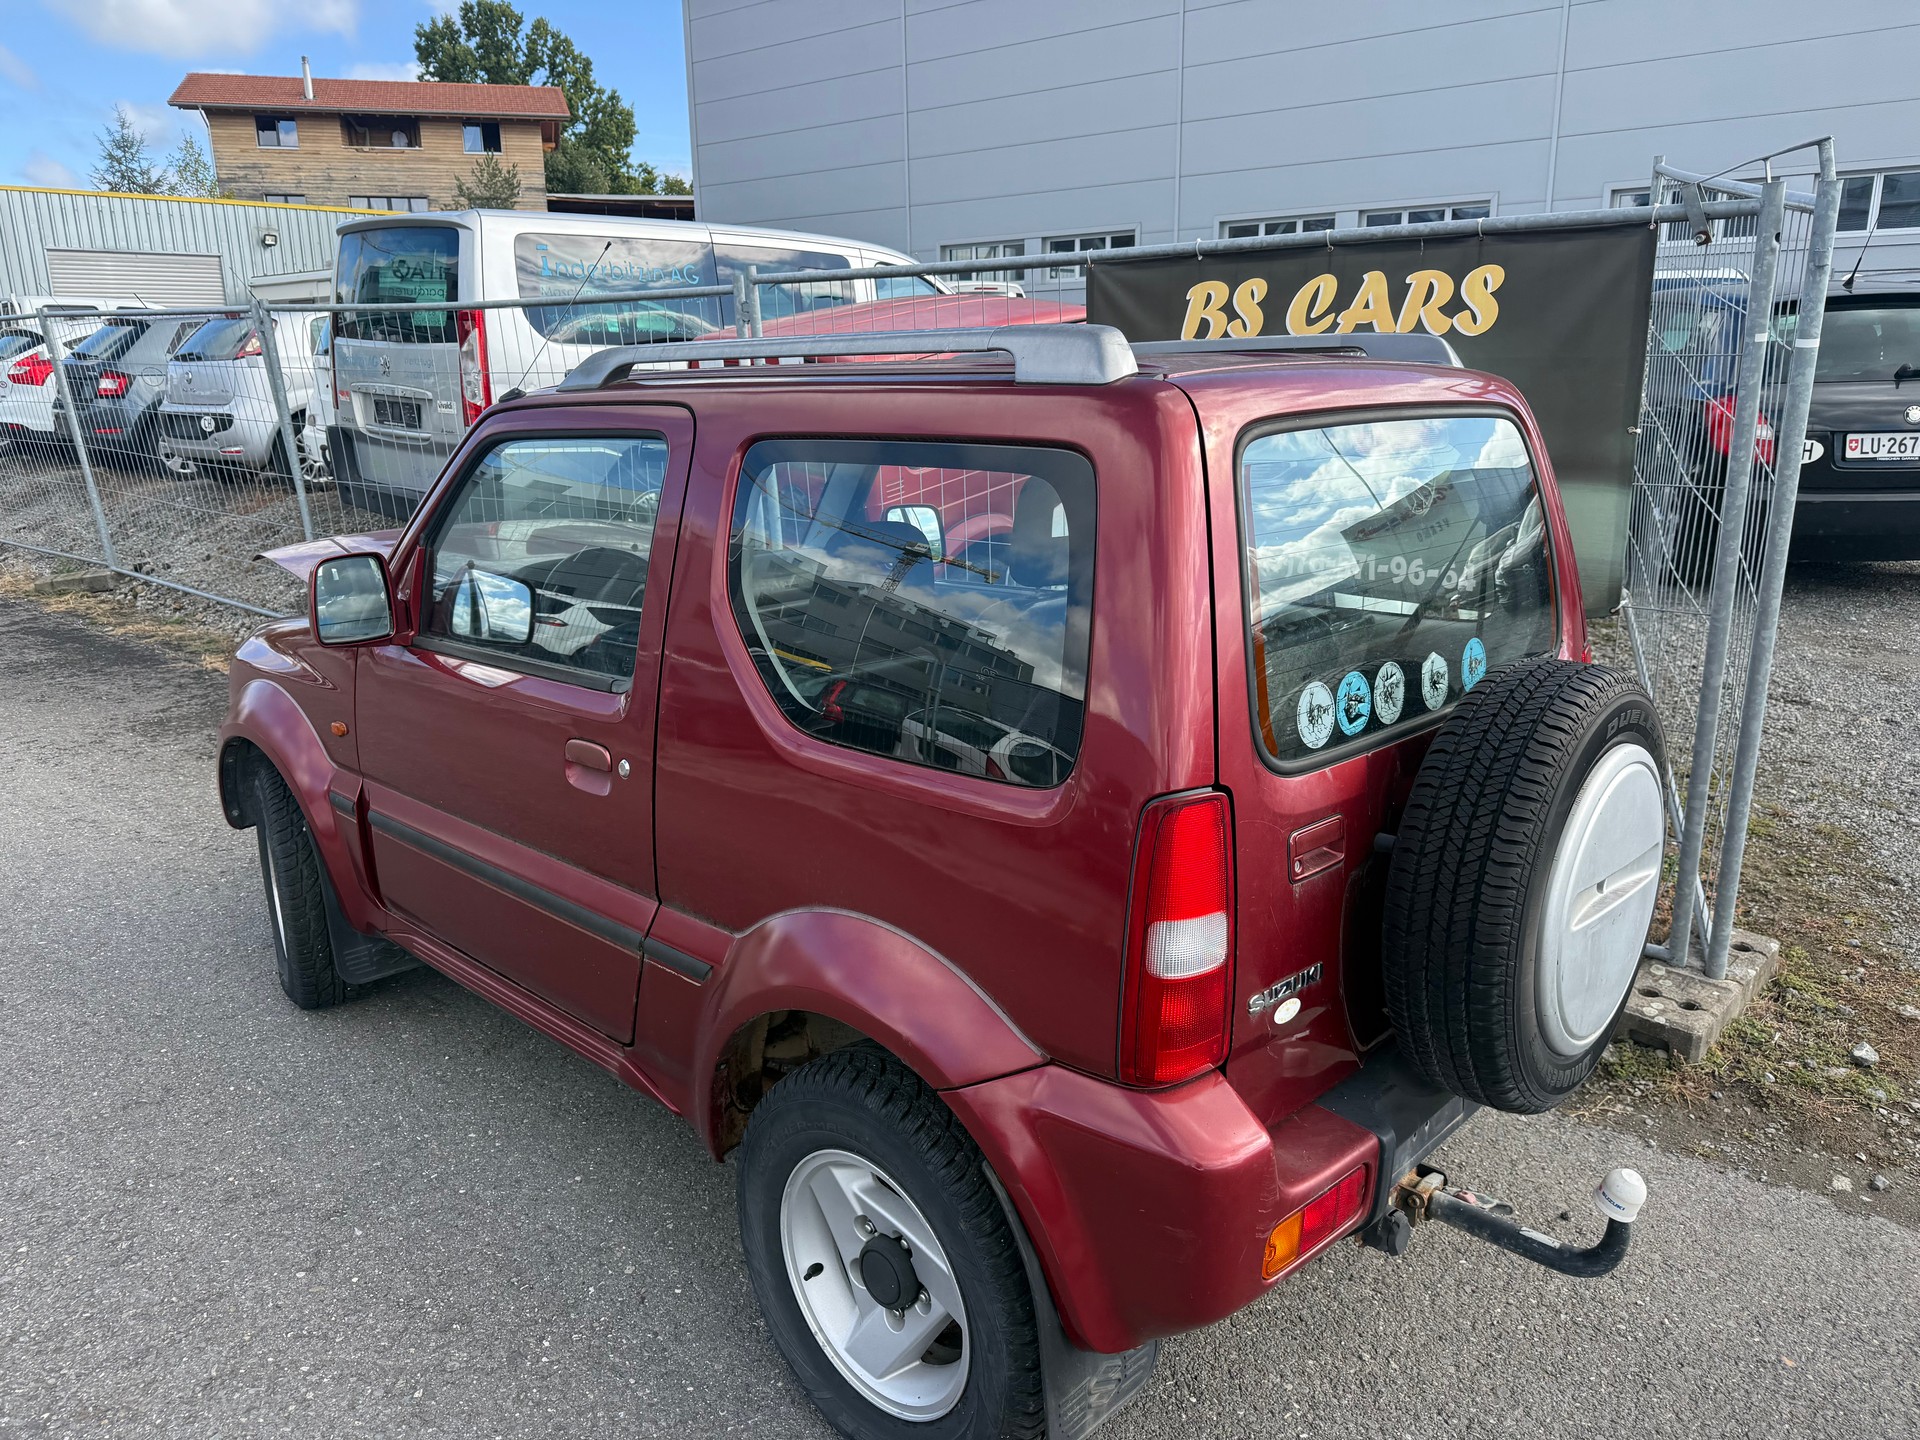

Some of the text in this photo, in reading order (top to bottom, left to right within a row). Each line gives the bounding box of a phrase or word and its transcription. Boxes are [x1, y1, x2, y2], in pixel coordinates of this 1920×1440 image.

[671, 264, 700, 285] AG
[1181, 264, 1506, 341] BS CARS
[203, 417, 213, 430] CH
[1801, 442, 1815, 461] H
[1246, 960, 1324, 1017] SUZUKI
[1601, 1190, 1626, 1211] SUZUKI
